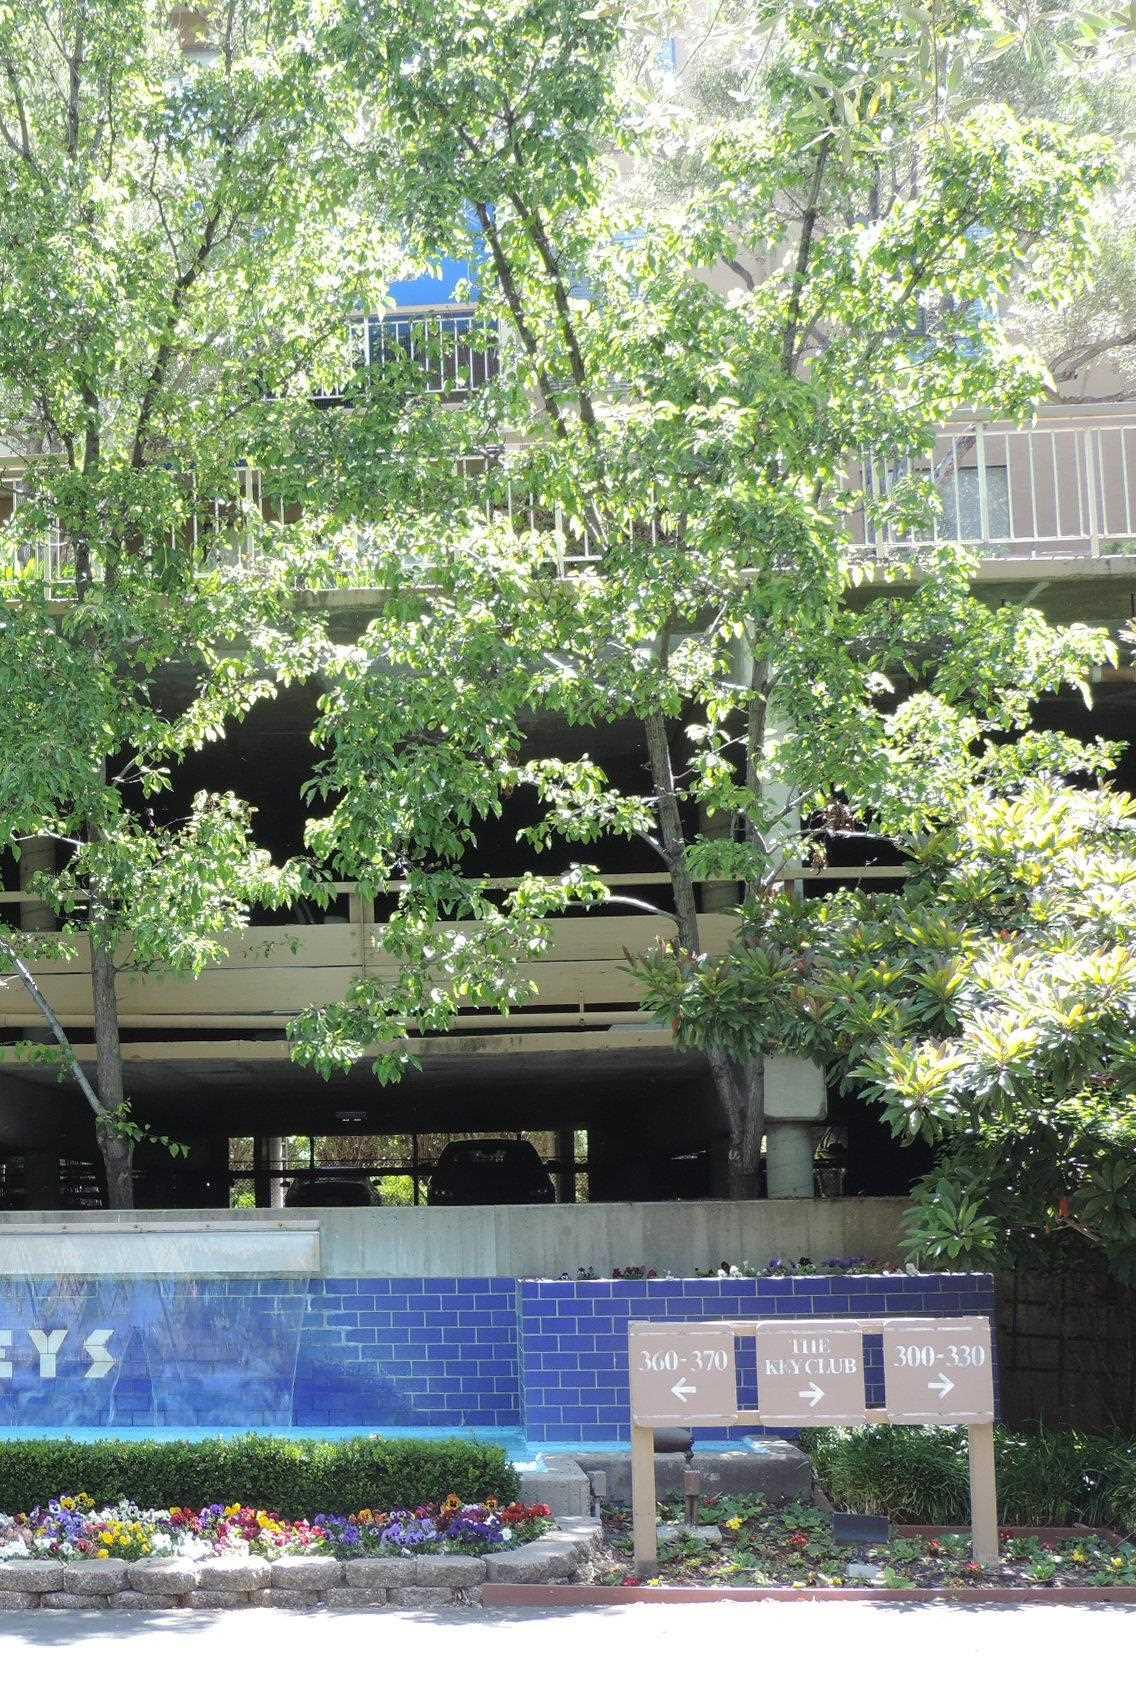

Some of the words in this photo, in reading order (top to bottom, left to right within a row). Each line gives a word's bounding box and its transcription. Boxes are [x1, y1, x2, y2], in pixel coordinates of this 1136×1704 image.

[788, 1336, 831, 1354] THE
[892, 1344, 985, 1368] 300-330
[638, 1350, 728, 1372] 360-370
